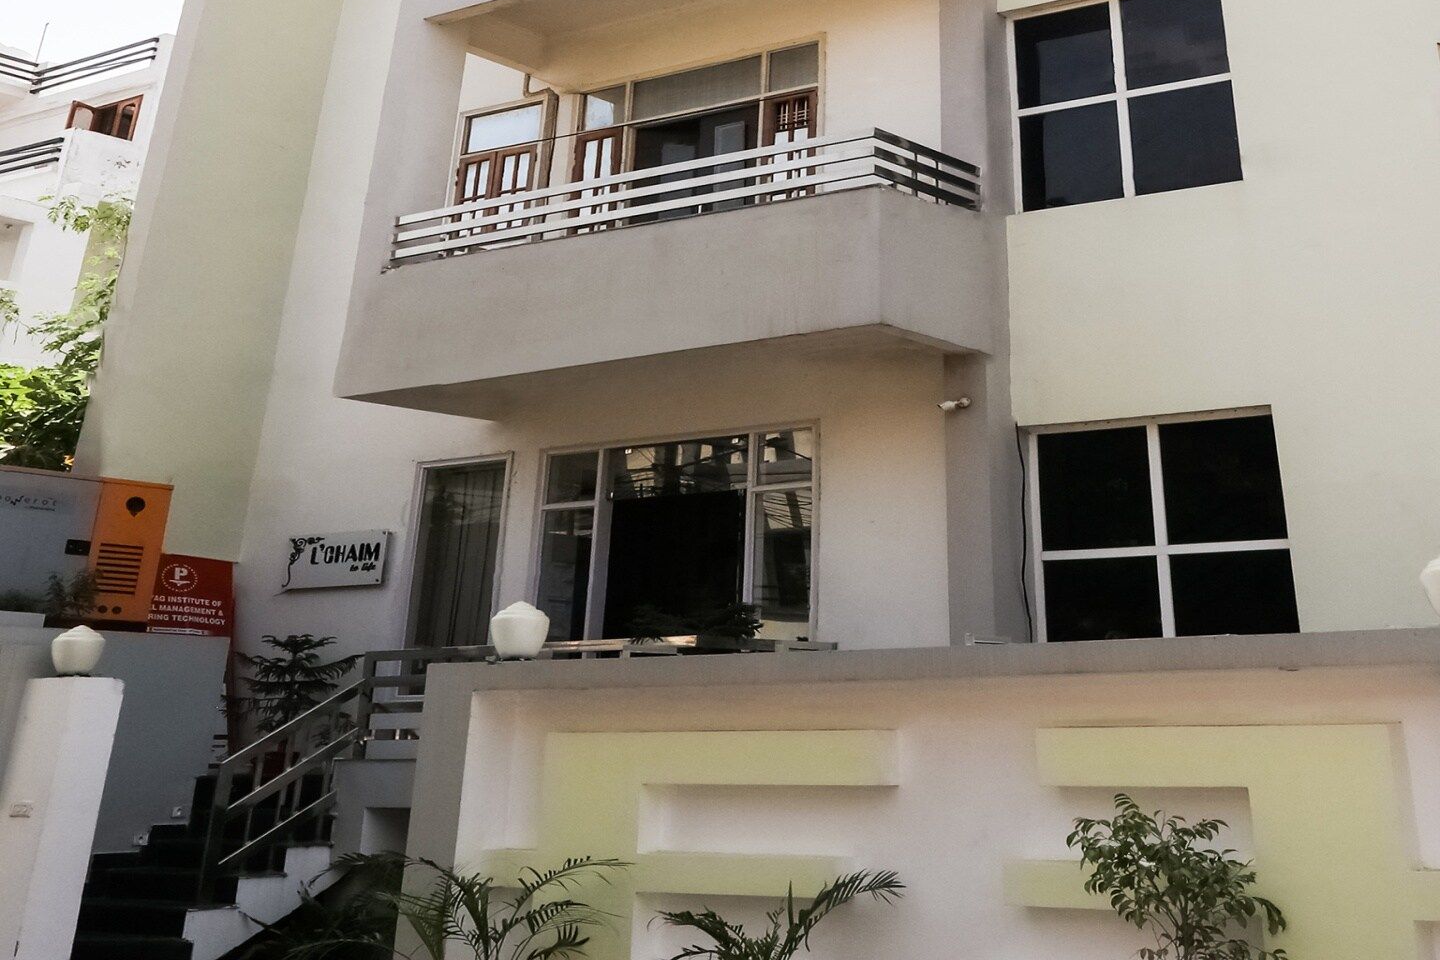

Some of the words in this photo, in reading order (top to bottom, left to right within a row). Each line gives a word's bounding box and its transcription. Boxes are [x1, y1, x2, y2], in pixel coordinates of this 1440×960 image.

[310, 542, 381, 565] L'CHAIM
[152, 595, 166, 603] AG
[167, 596, 210, 606] INSTITUTE
[159, 604, 217, 616] MANAGEMENT
[172, 614, 226, 626] TECHNOLOGY
